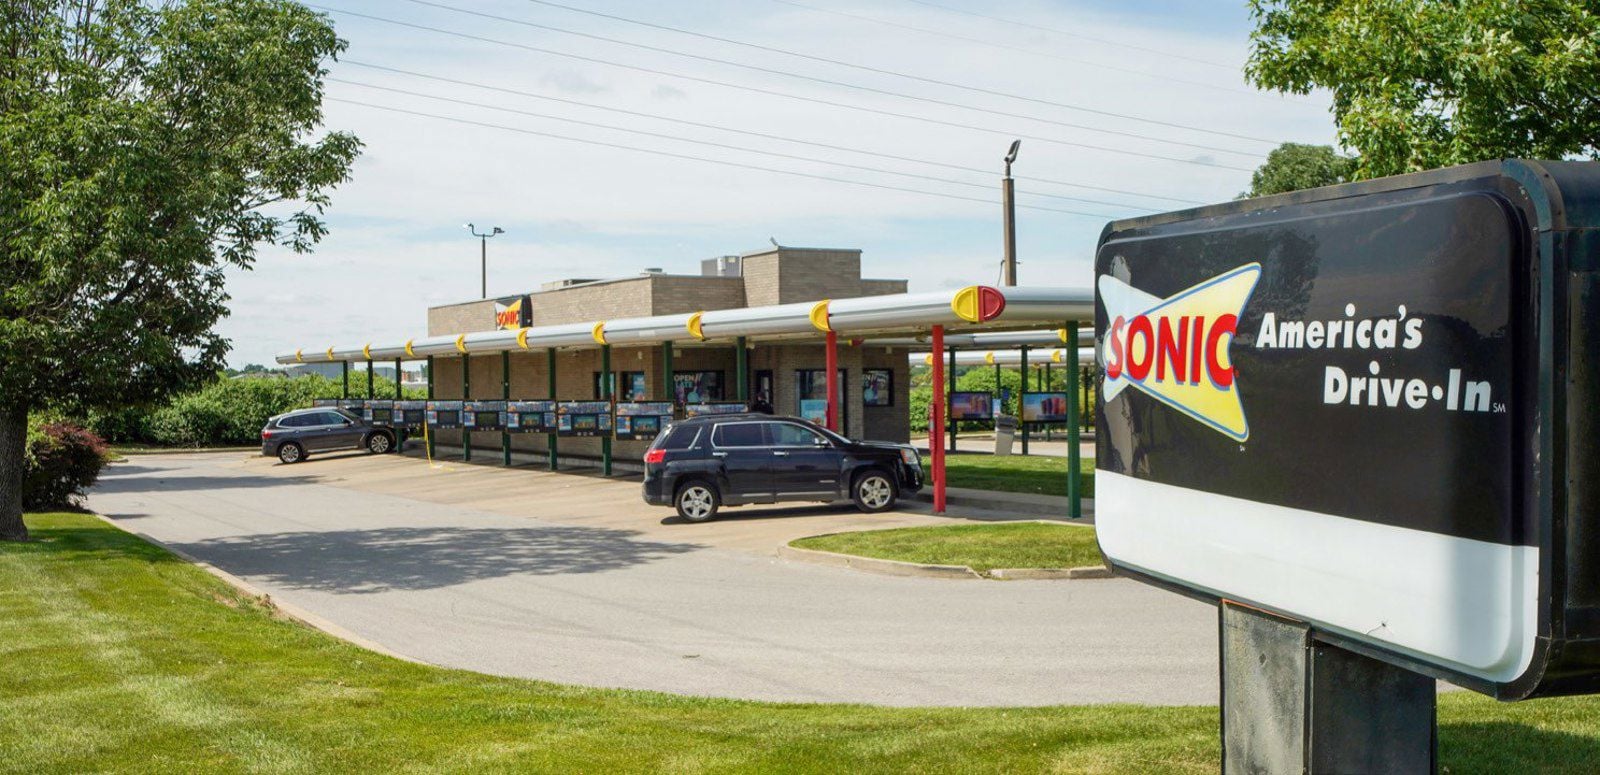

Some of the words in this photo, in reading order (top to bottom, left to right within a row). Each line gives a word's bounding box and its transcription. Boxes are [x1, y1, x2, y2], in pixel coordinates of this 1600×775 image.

[496, 311, 520, 326] SONIC
[1255, 302, 1424, 350] America's
[1106, 313, 1238, 391] SONIC
